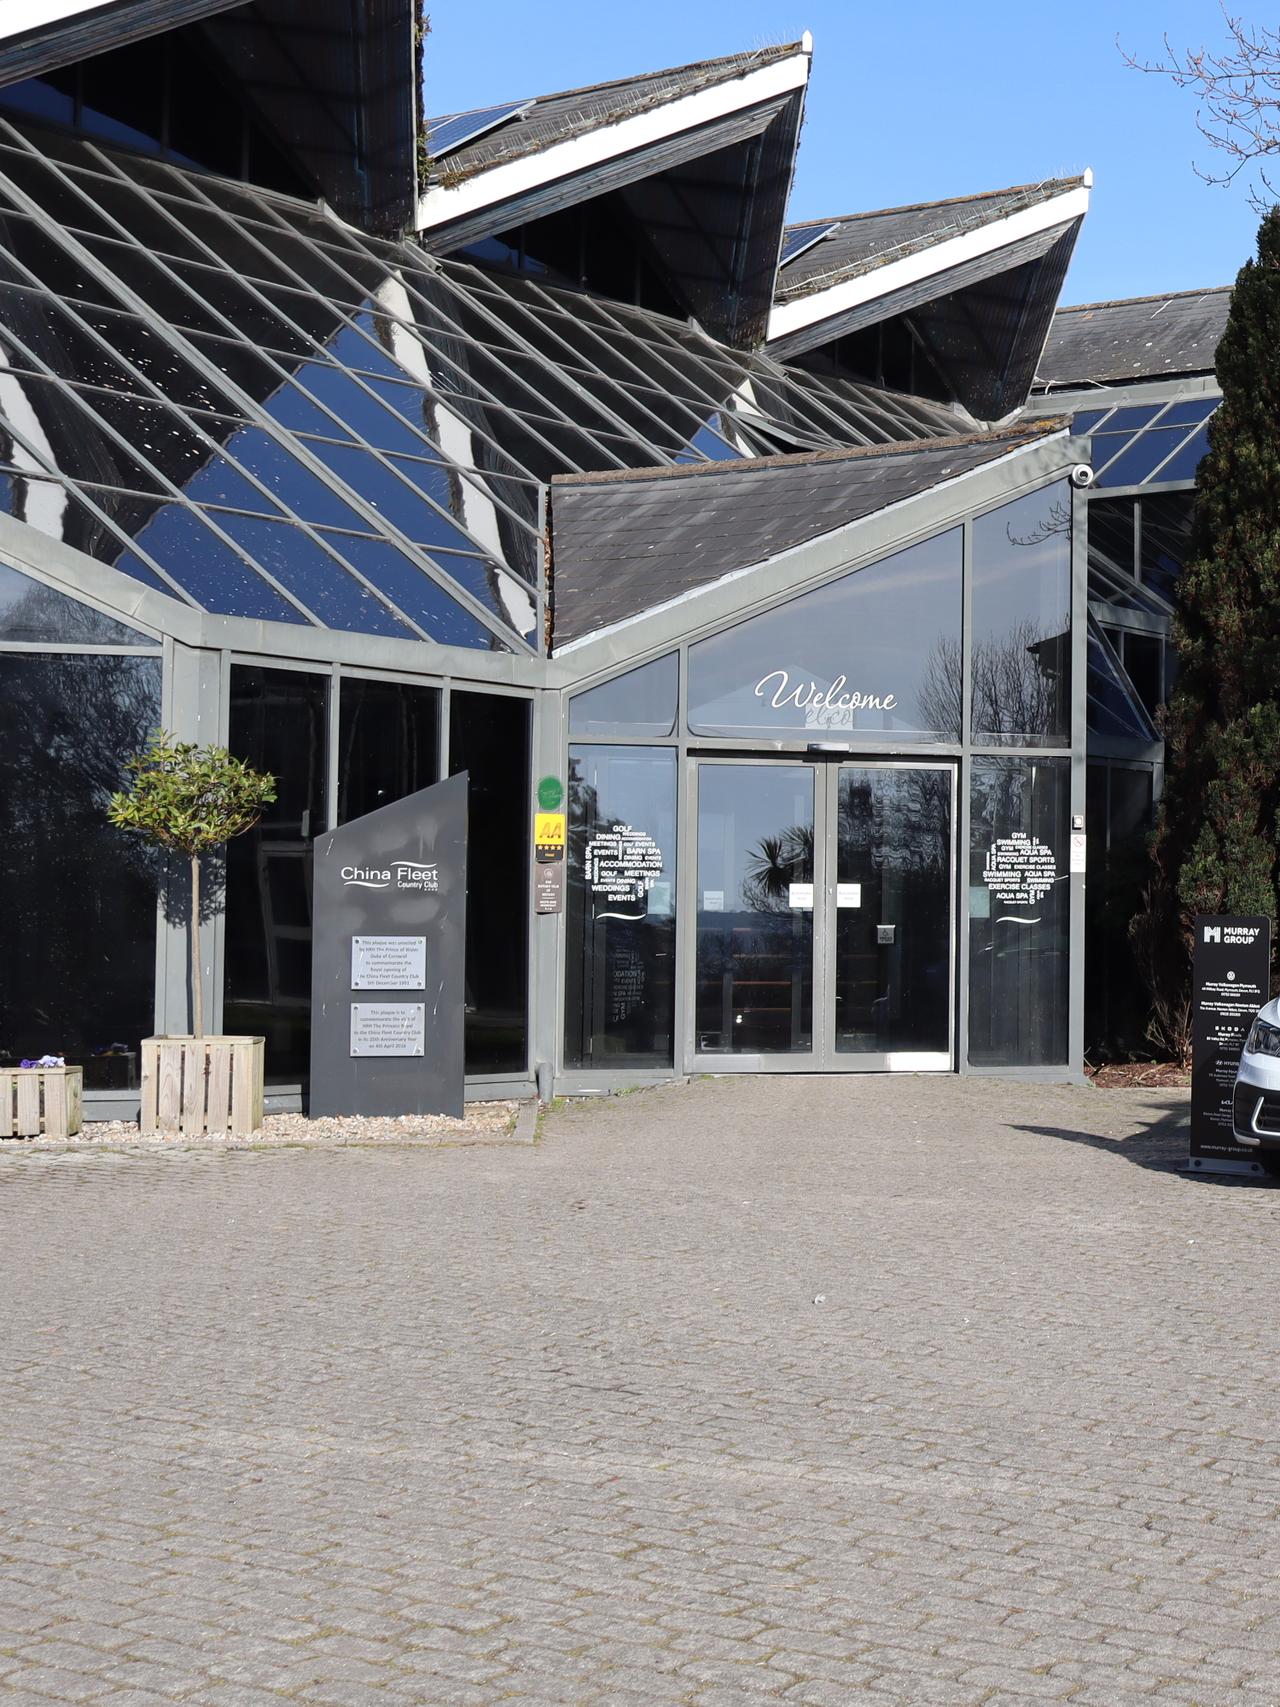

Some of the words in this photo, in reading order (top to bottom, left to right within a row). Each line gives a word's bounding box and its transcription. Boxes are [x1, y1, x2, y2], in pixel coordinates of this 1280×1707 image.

[754, 670, 898, 710] Welcome
[596, 833, 621, 841] DINING
[341, 866, 391, 880] China
[397, 867, 439, 880] Fleet
[397, 881, 422, 889] Country
[1224, 927, 1260, 936] MURRAY
[1224, 936, 1255, 944] GROUP
